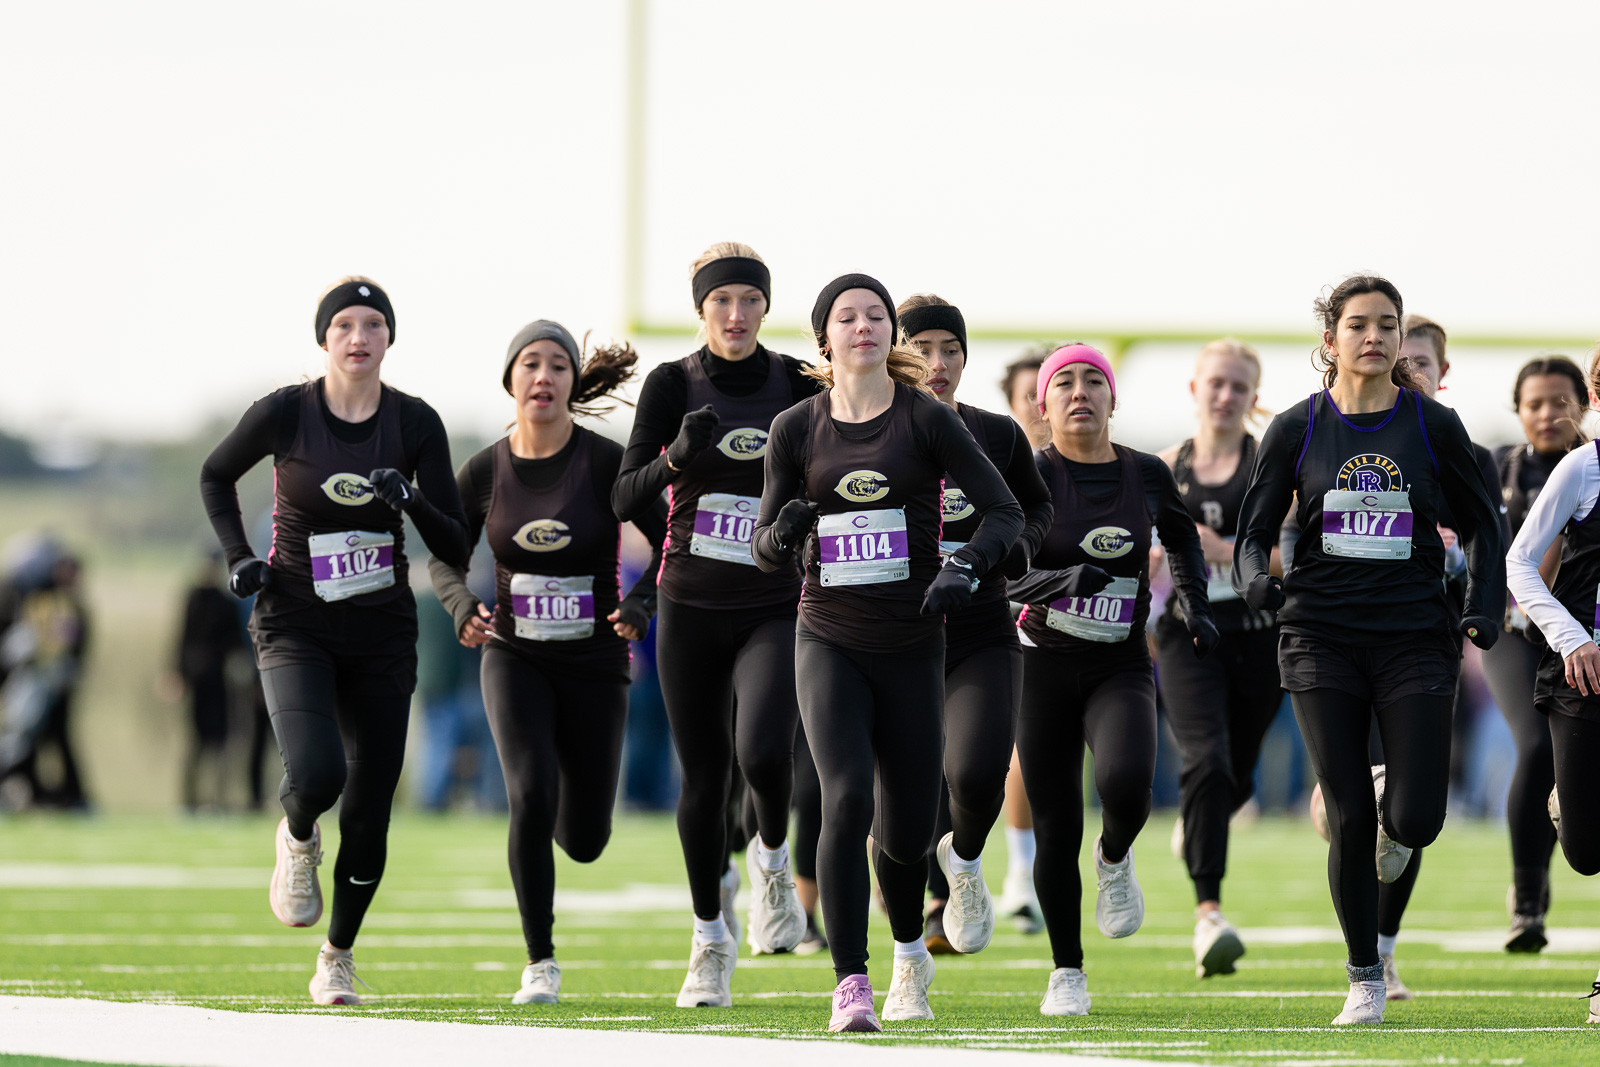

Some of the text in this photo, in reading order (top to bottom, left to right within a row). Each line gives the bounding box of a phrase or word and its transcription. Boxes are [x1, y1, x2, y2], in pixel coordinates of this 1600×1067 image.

[1340, 457, 1399, 479] RIVER ROAD
[834, 470, 890, 503] C
[1361, 495, 1379, 508] C
[710, 514, 757, 542] 110
[851, 515, 869, 529] C
[1340, 511, 1398, 536] 1077
[512, 519, 572, 552] C
[835, 533, 893, 561] 1104
[1079, 526, 1134, 559] C
[328, 548, 381, 579] 1102
[527, 596, 581, 620] 1106
[1066, 597, 1122, 622] 1100
